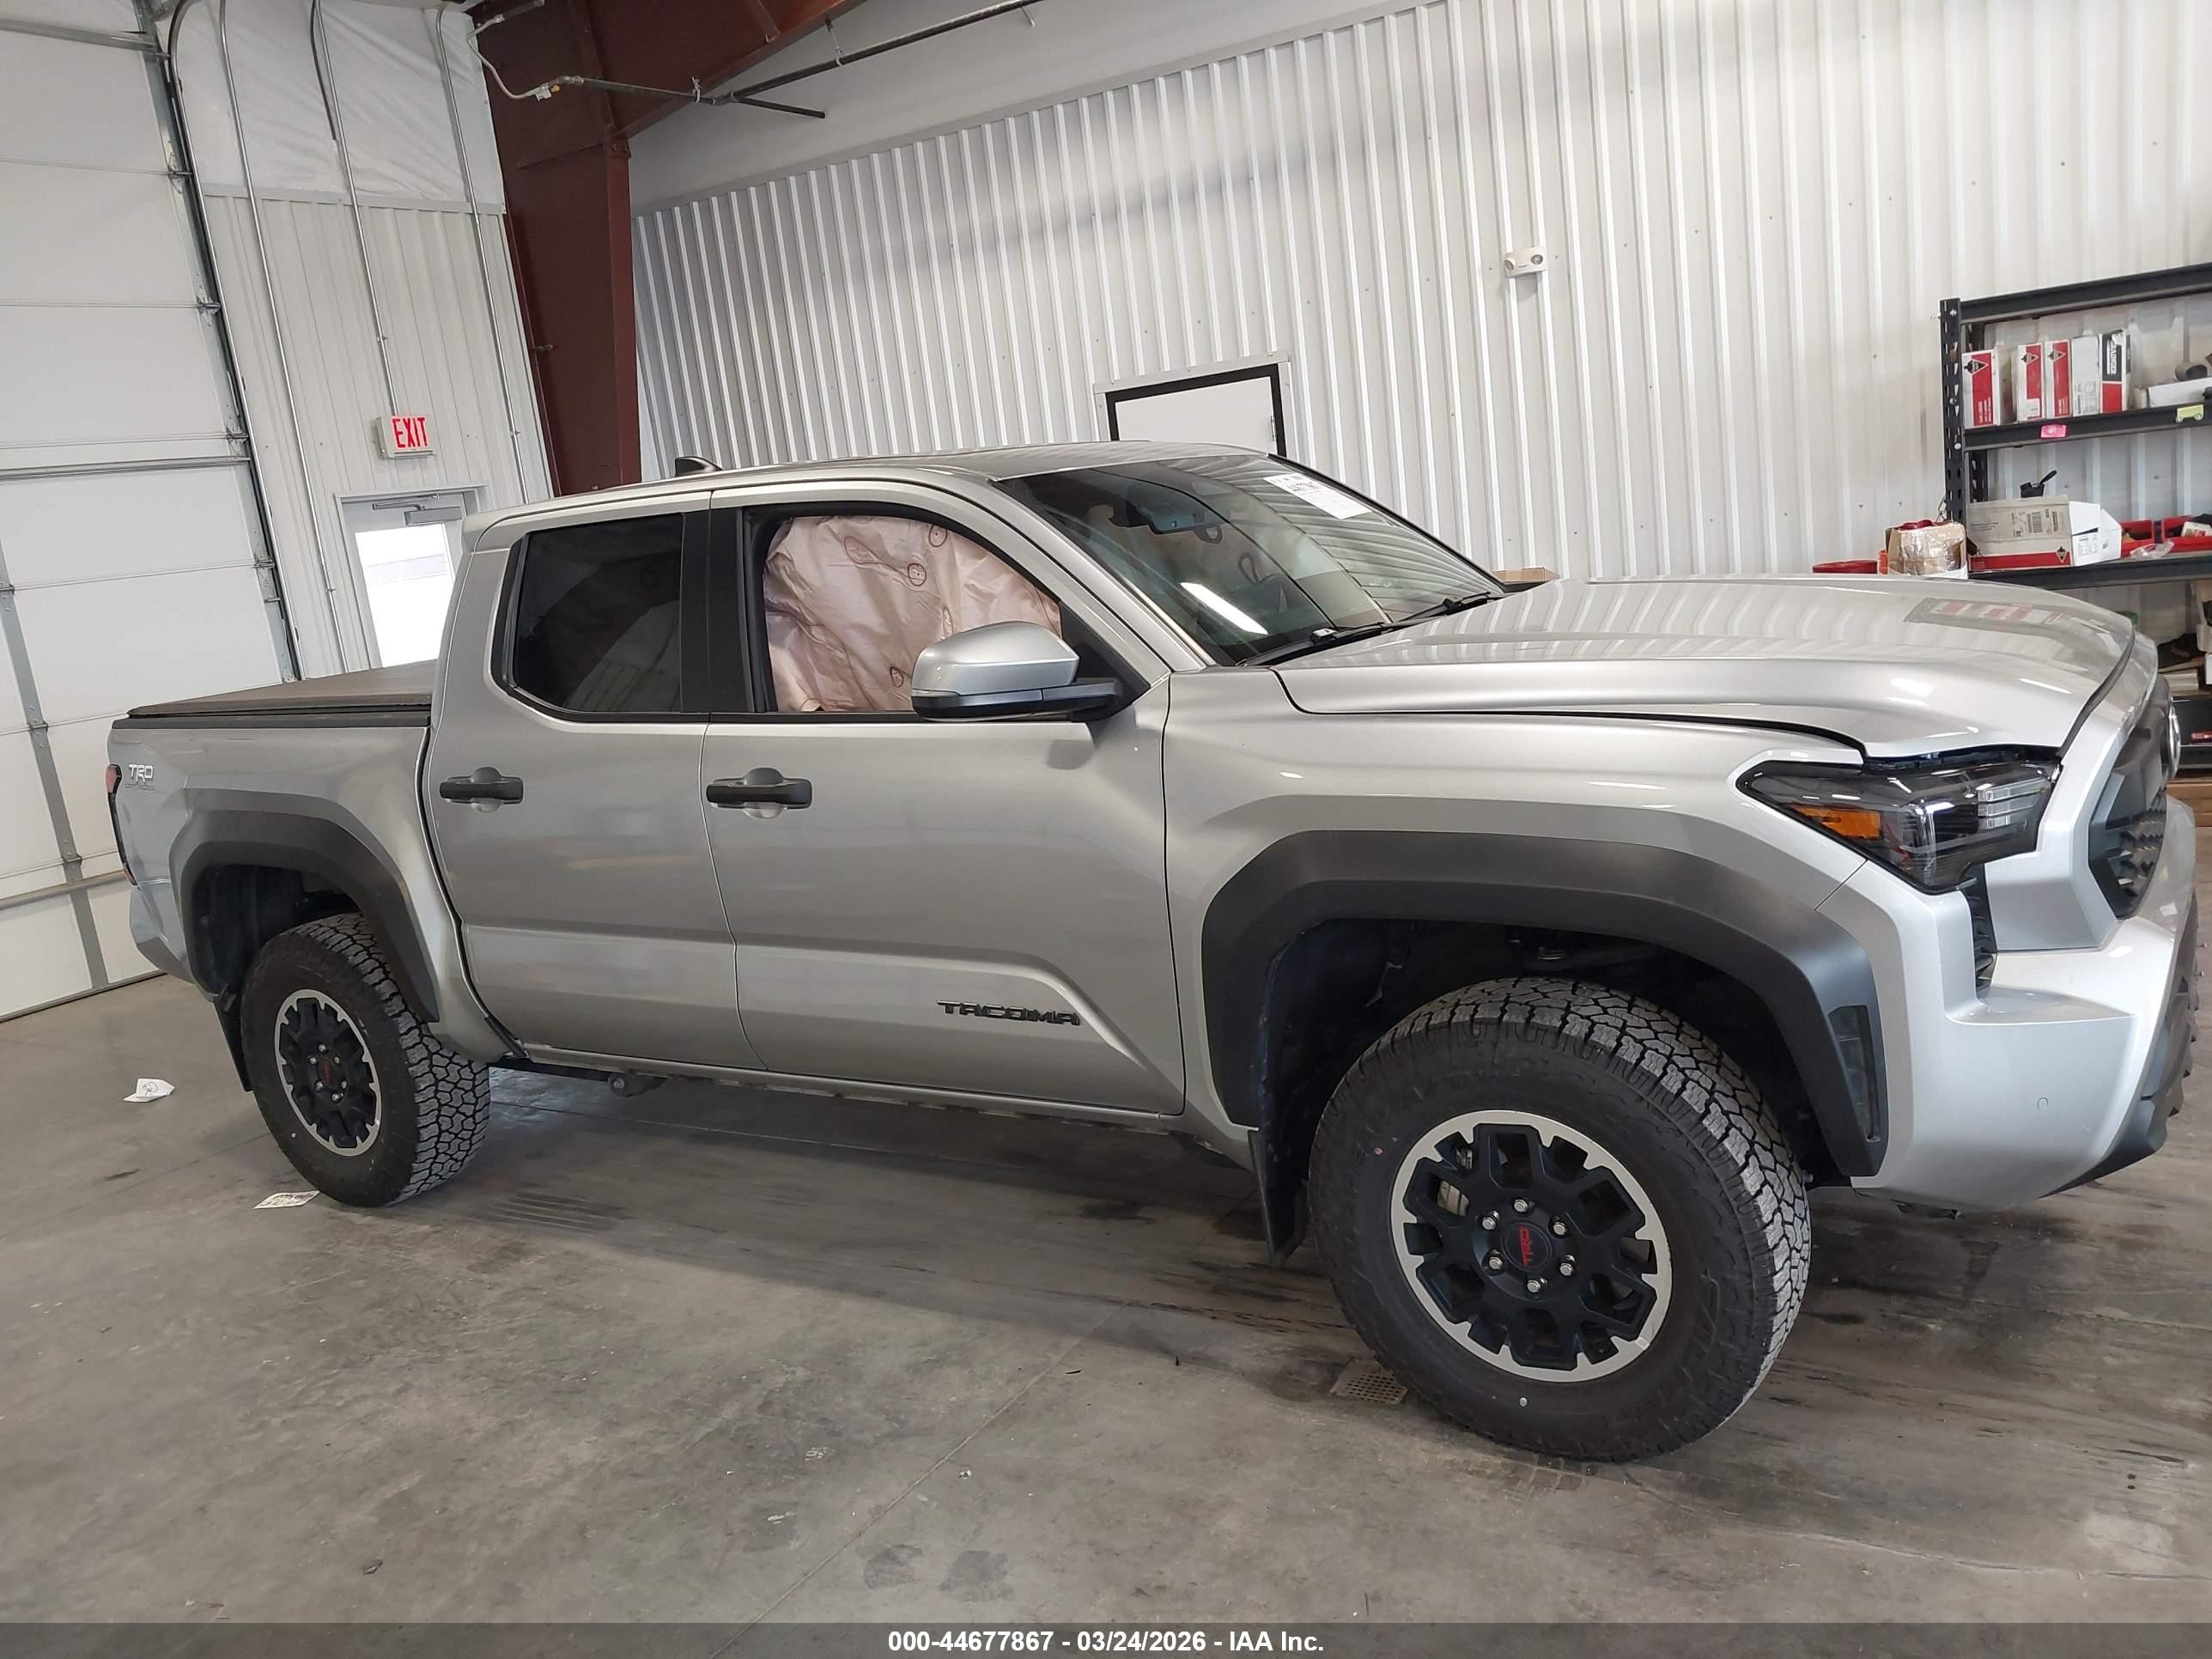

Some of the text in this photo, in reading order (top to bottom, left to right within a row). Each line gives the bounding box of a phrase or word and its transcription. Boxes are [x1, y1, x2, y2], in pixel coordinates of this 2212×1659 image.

[392, 416, 428, 448] EXIT
[129, 763, 153, 782] TRD
[937, 1000, 1080, 1026] TACOMA
